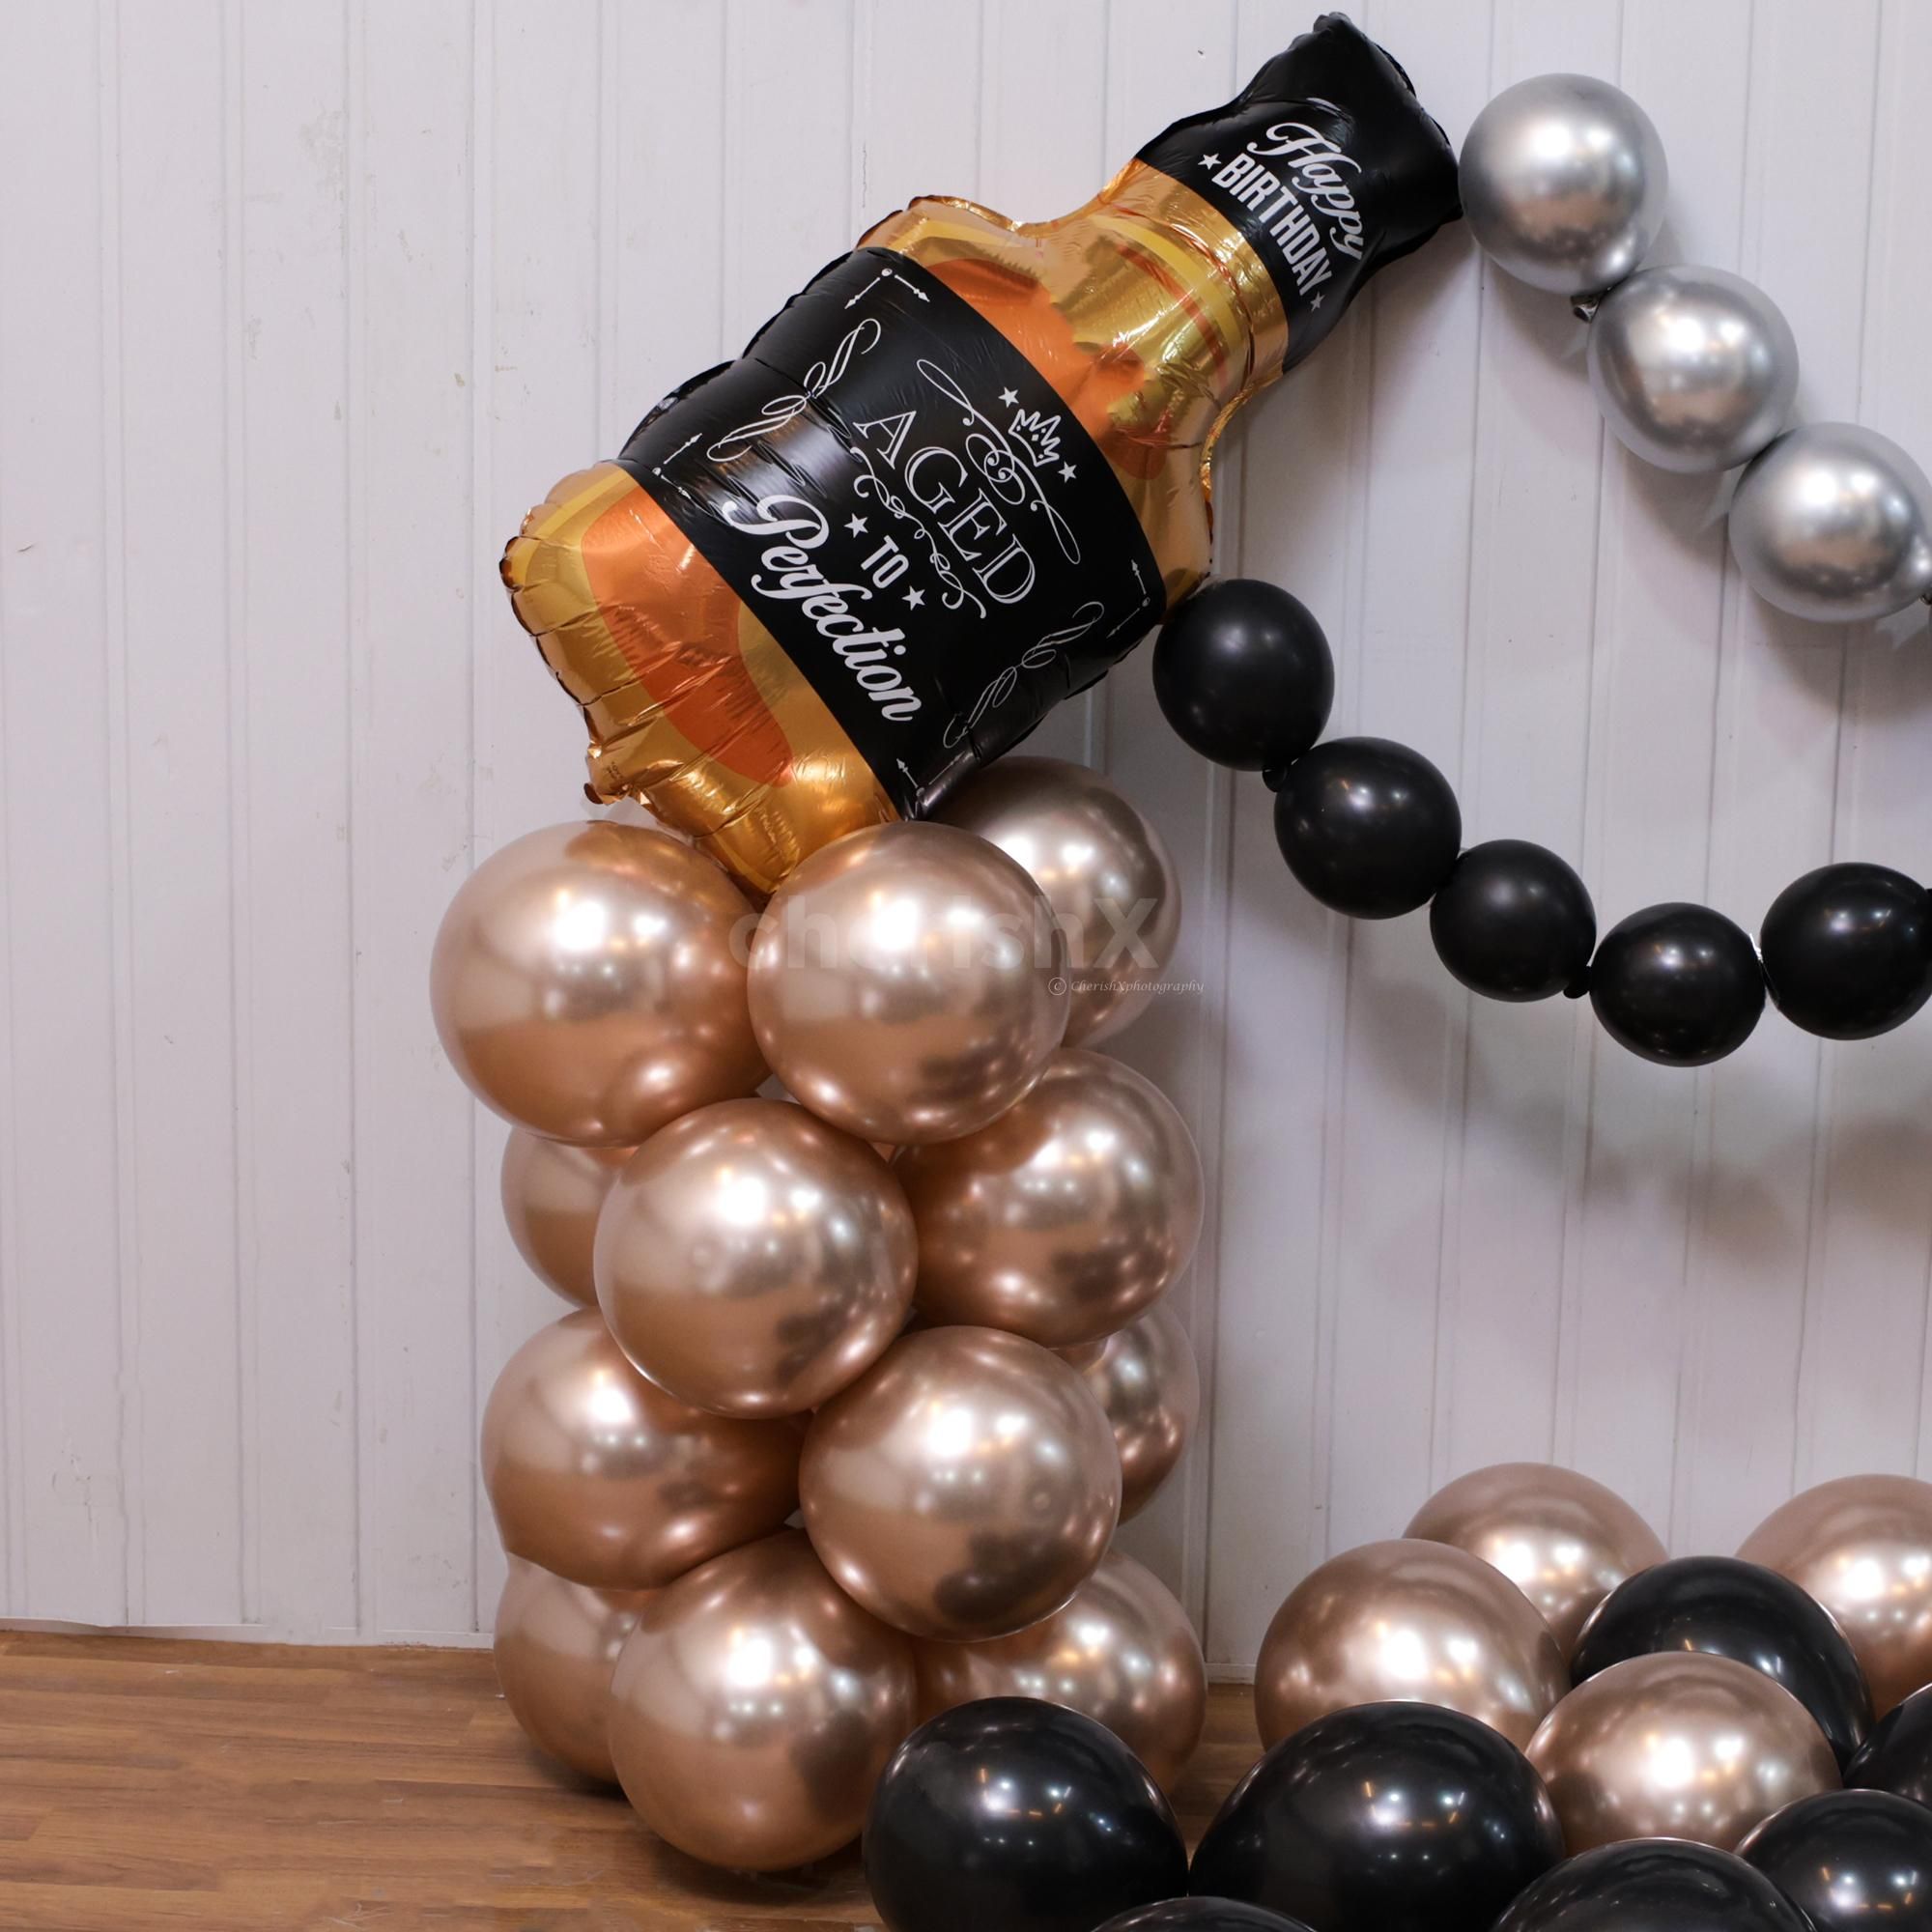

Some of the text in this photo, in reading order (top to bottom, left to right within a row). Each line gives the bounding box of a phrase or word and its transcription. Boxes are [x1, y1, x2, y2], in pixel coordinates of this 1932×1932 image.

[1211, 153, 1332, 296] BIRTHDAY
[1247, 123, 1362, 260] Happy
[853, 411, 1036, 604] AGED
[861, 535, 909, 588] TO
[723, 495, 922, 722] Perfection
